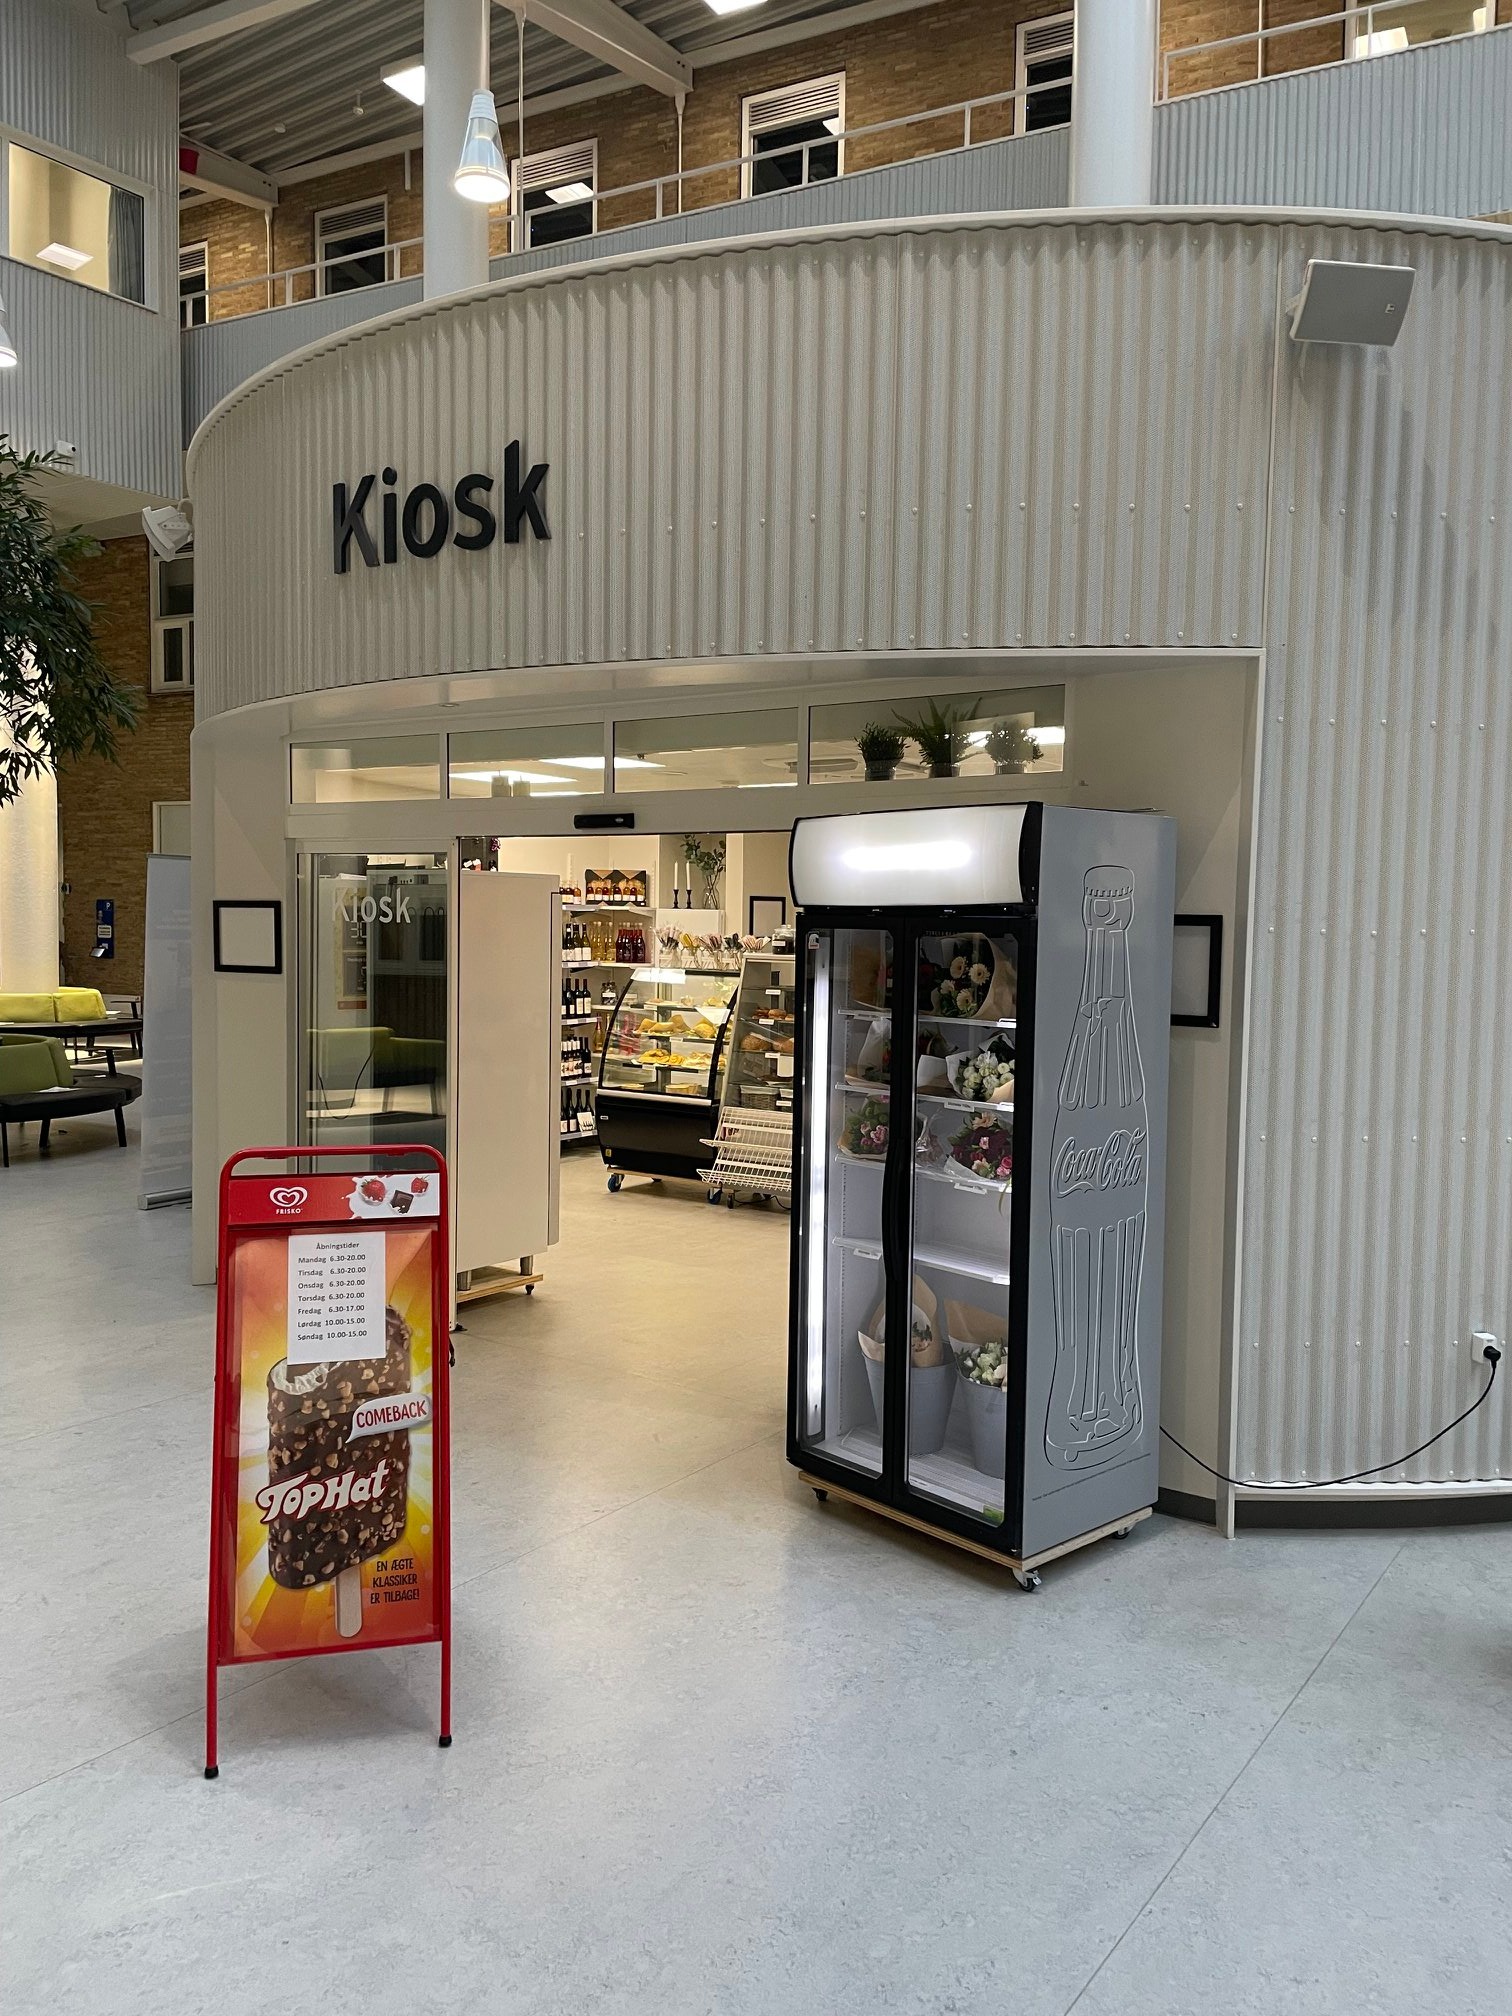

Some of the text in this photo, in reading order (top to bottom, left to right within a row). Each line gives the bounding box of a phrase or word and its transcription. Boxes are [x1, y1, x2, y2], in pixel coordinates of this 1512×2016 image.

[333, 439, 550, 574] Kiosk
[332, 887, 411, 923] Kiosk
[316, 1242, 360, 1251] Åbningstider
[298, 1254, 366, 1264] Mandag 6.30-20.00
[298, 1266, 366, 1277] Tirsdag 6.30-20.00
[298, 1279, 365, 1290] Onsdag 6.30-20.00
[298, 1292, 365, 1302] Torsdag 6.30-20.00
[298, 1304, 365, 1315] Fredag 6.30-17.00
[298, 1317, 365, 1328] Lørdag 10.00-15.00
[298, 1330, 367, 1341] Søndag 10.00-15.00
[356, 1400, 427, 1428] COMEBACK
[376, 1558, 414, 1572] EN ÆGTE
[373, 1573, 417, 1588] KLASSIKER
[370, 1588, 420, 1604] ER TILBAGE!
